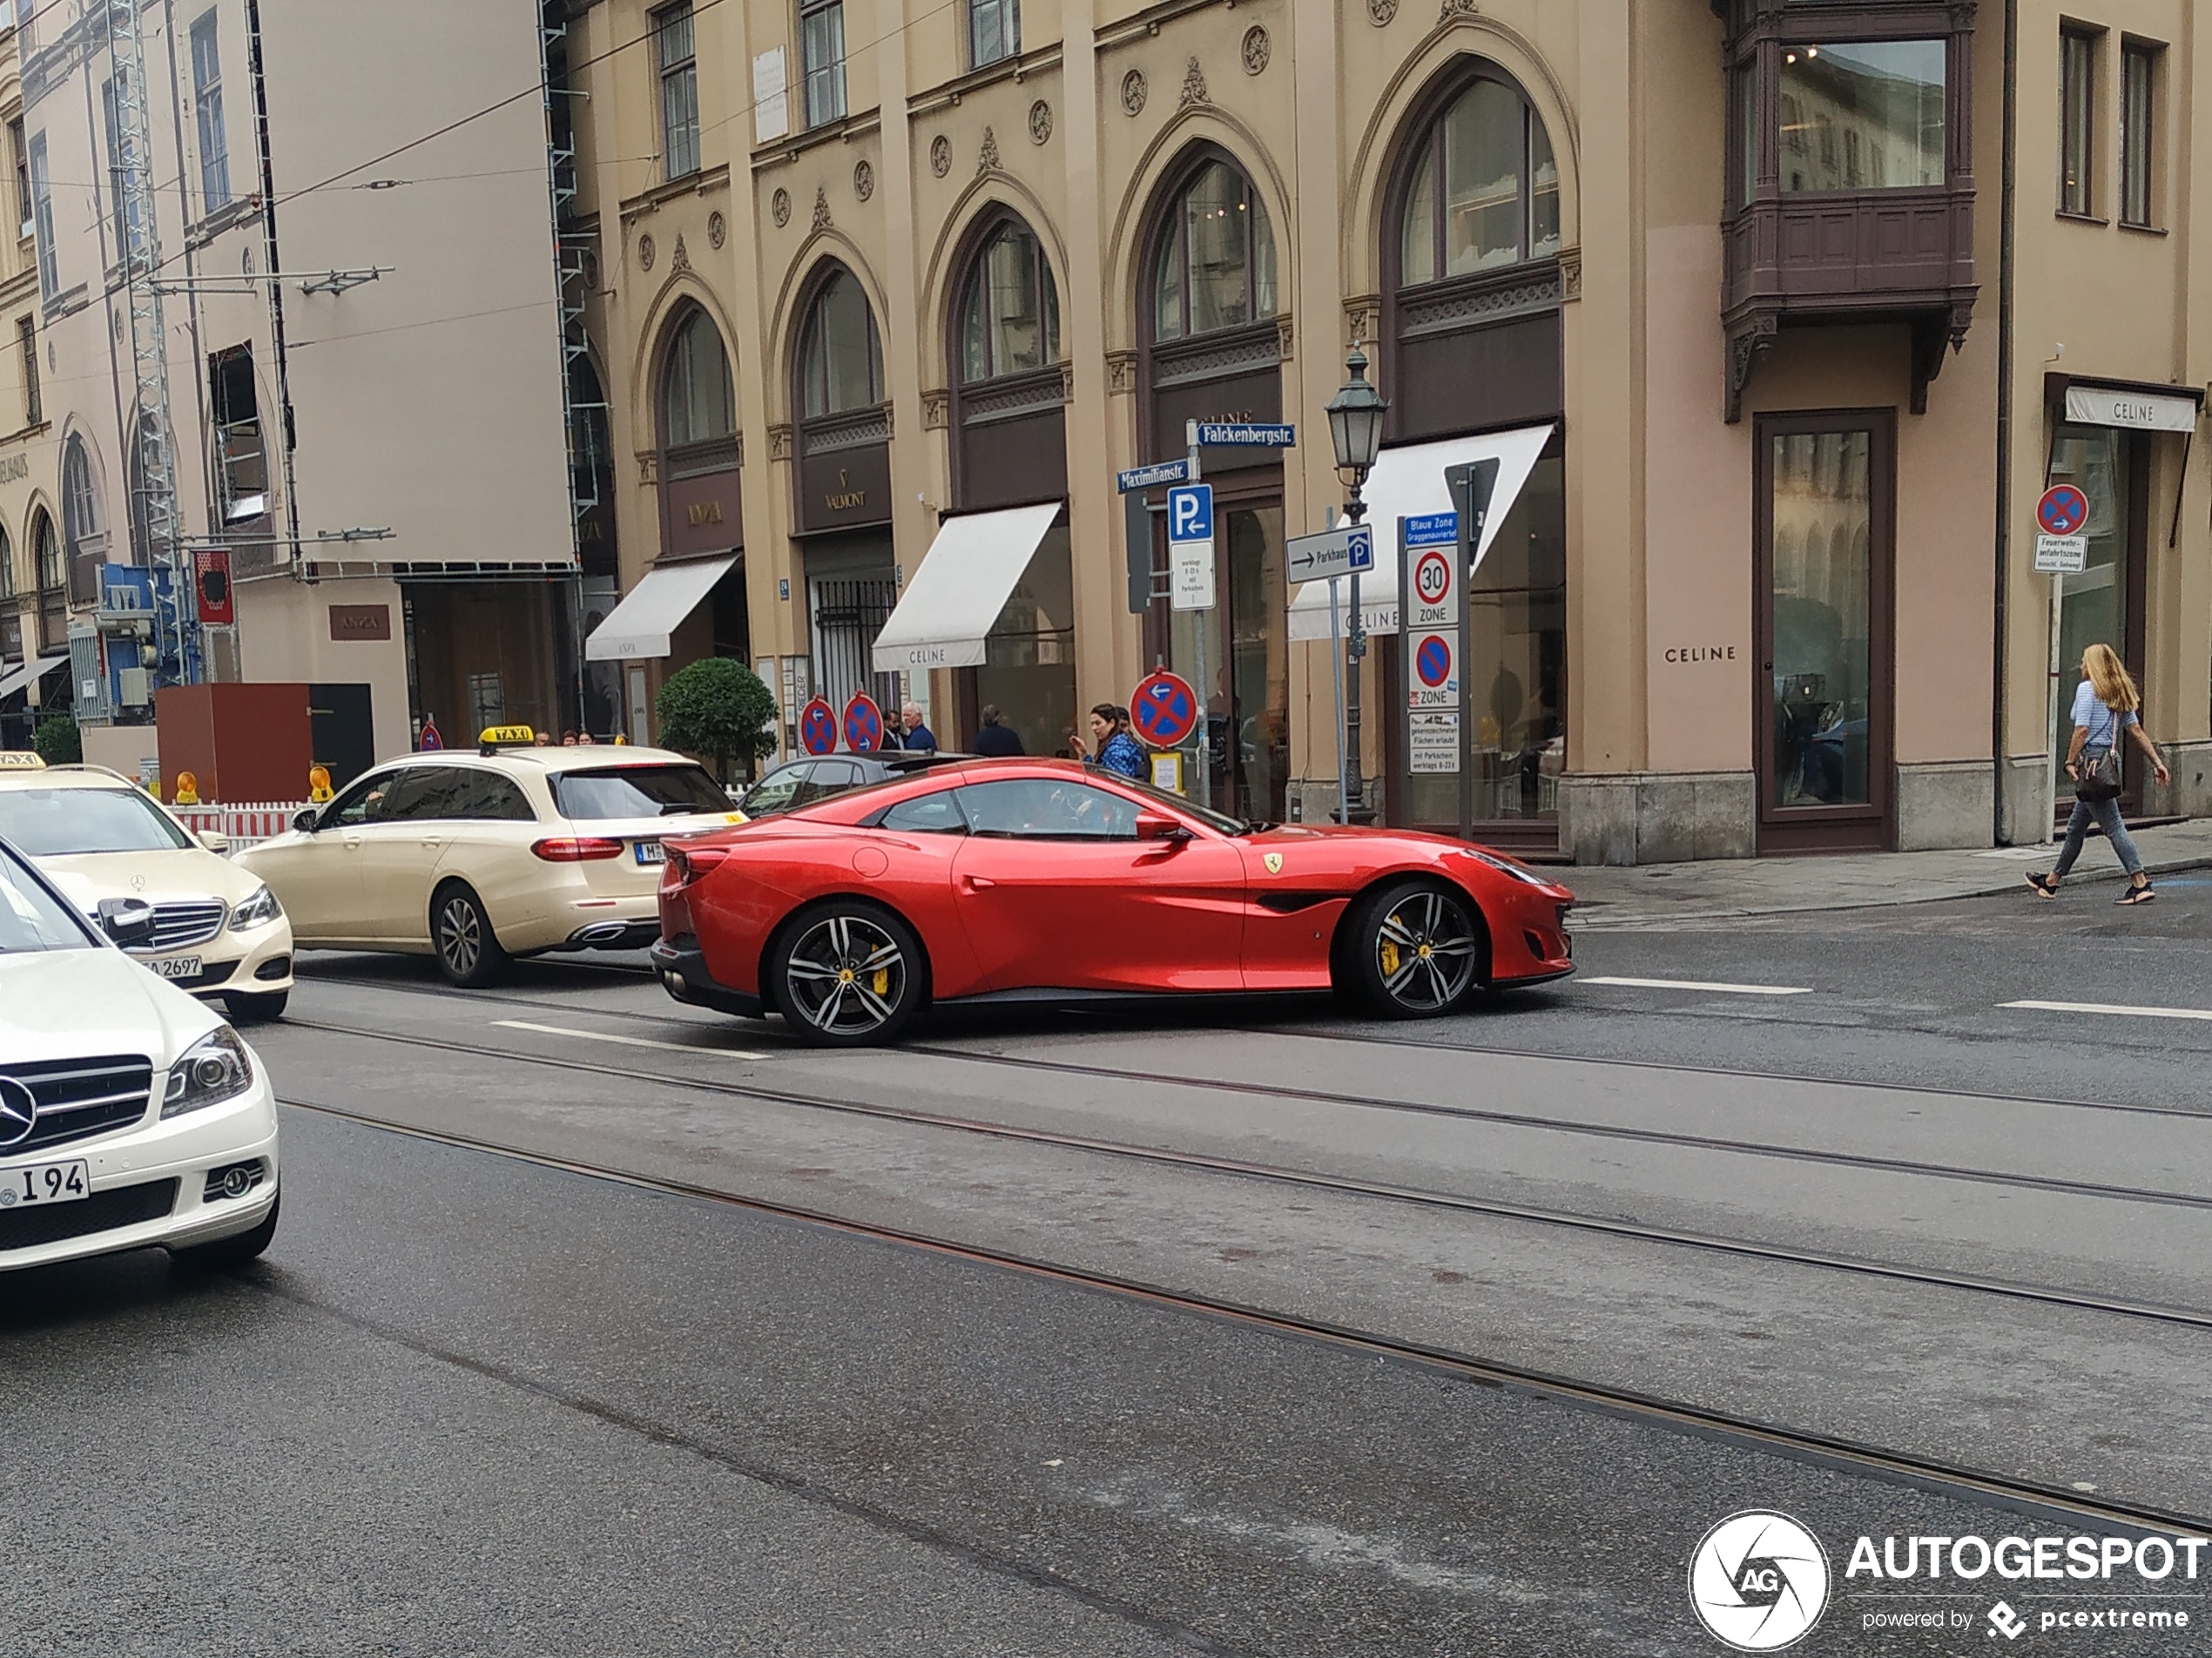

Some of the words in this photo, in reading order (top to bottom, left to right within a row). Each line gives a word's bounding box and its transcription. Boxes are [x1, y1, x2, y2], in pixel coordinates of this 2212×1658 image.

[2114, 402, 2154, 421] CELINE
[1204, 426, 1291, 446] Falckenbergstr.
[1121, 465, 1184, 489] Maximilianstr.
[825, 491, 865, 509] VALMONT
[1176, 494, 1199, 536] P
[1411, 520, 1432, 531] Blaue
[1434, 517, 1453, 529] Zone
[1407, 529, 1457, 543] Graggenauviertel
[2041, 537, 2080, 547] Feuerwehr-
[1317, 549, 1348, 564] Parkhaus
[2039, 549, 2081, 557] anfahrtszone
[1422, 566, 1443, 590] 30
[1420, 608, 1447, 622] ZONE
[909, 649, 945, 664] CELINE
[1665, 646, 1736, 663] CELINE
[1421, 691, 1447, 704] ZONE
[496, 729, 529, 740] TAXI
[647, 845, 656, 859] M
[163, 958, 199, 976] 2697
[23, 1170, 38, 1201] I
[44, 1165, 84, 1198] 94
